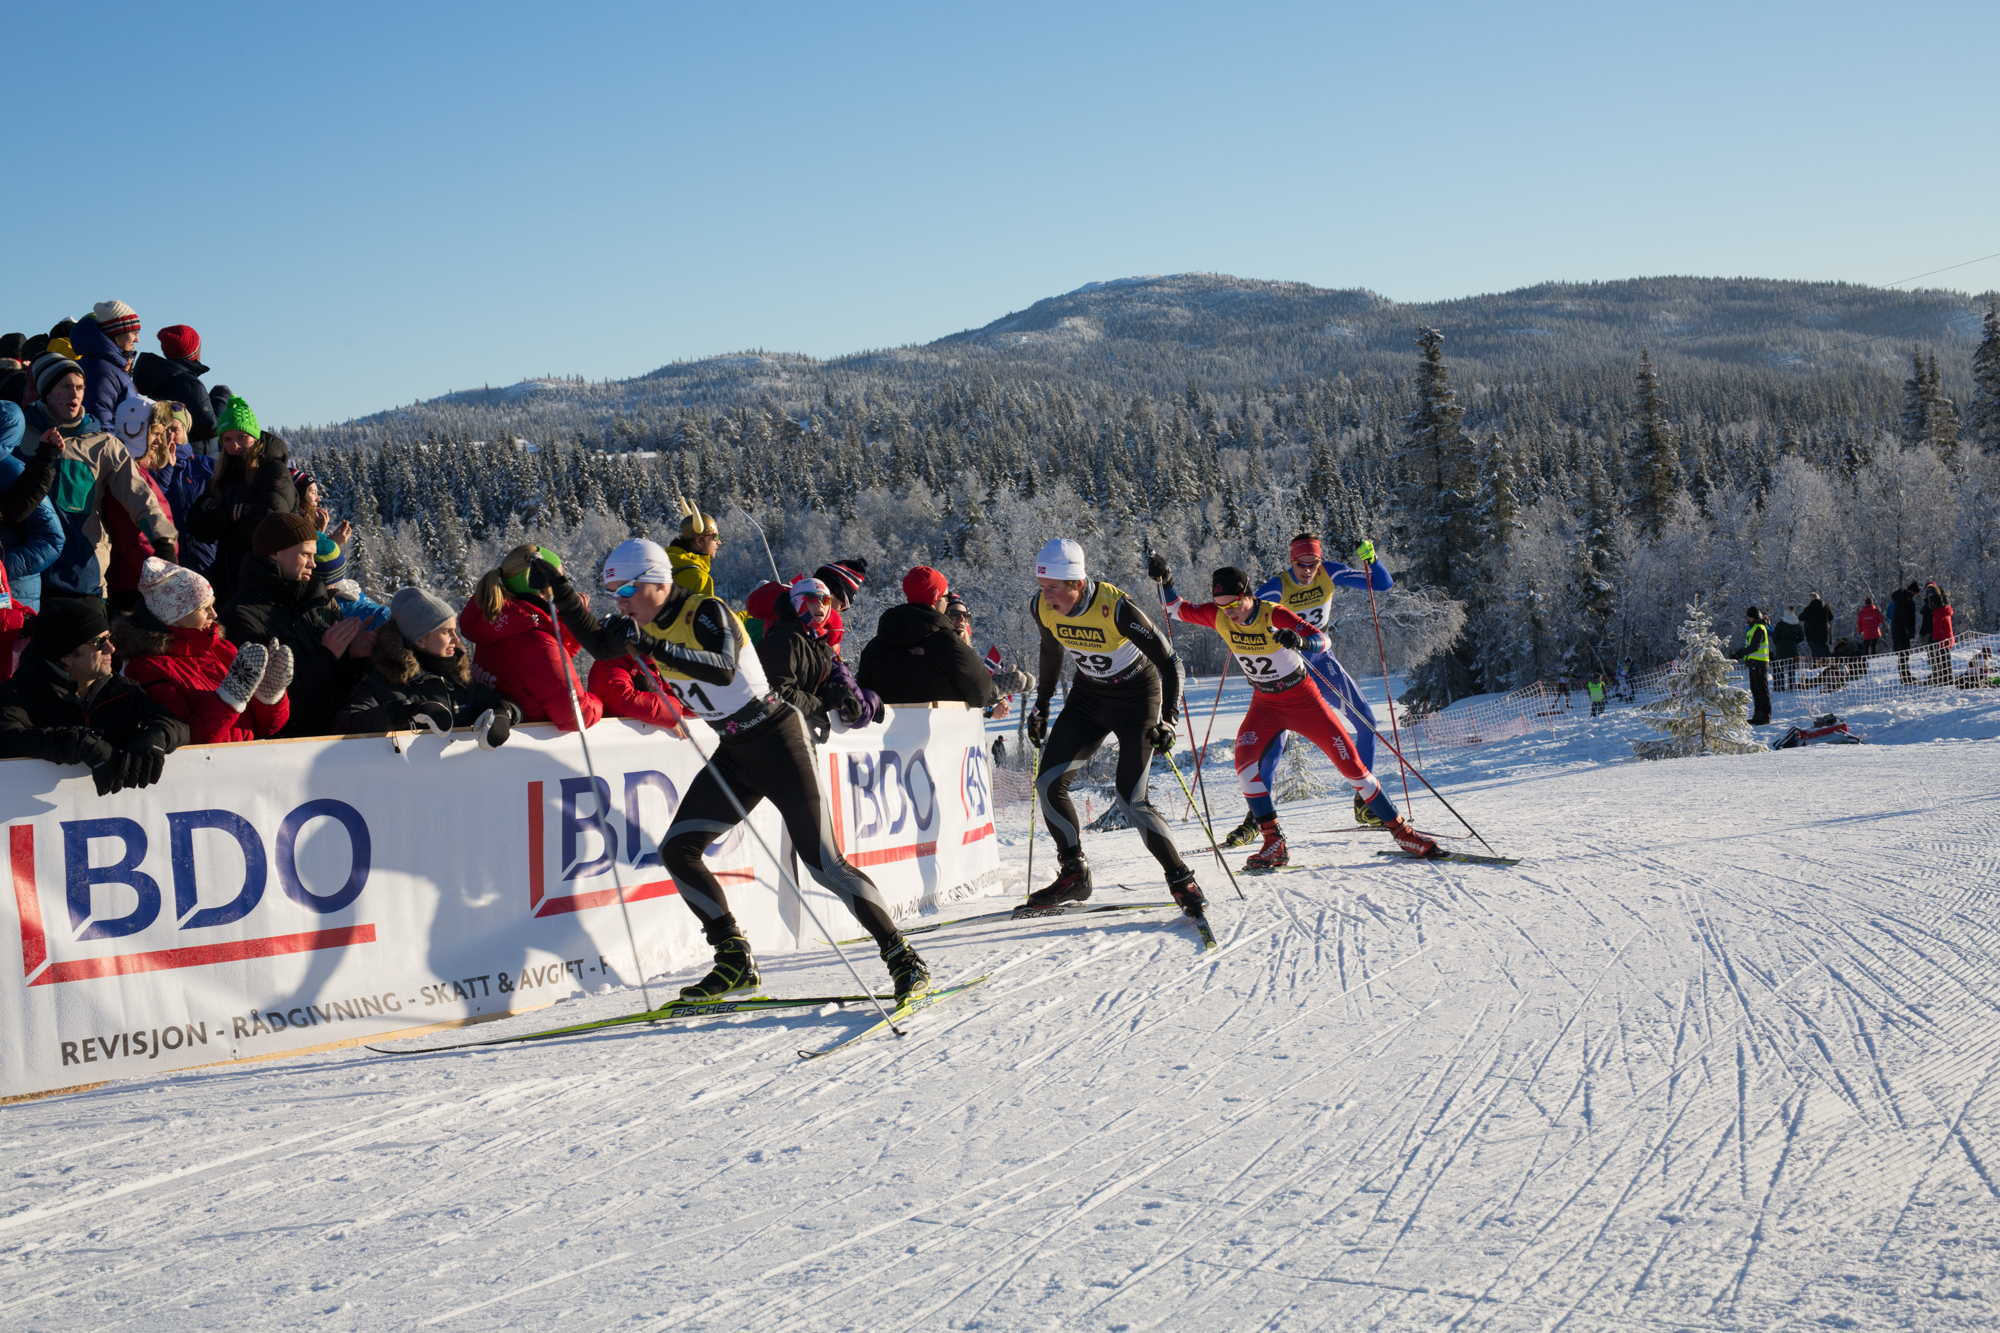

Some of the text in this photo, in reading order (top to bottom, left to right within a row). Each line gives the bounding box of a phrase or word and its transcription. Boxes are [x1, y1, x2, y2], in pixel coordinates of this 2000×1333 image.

[1290, 589, 1323, 603] GLAVA
[1058, 627, 1103, 641] GLAVA
[1232, 634, 1265, 645] GLAVA
[1064, 640, 1102, 648] ISOLASJON
[1239, 656, 1277, 675] 32
[739, 712, 767, 731] Statoil
[846, 749, 936, 840] BDO
[59, 798, 371, 942] BDO
[1010, 908, 1065, 921] FISCHER
[61, 1021, 208, 1066] REVISJON
[232, 992, 403, 1040] RÅDGIVNING
[419, 975, 490, 1007] SKATT
[498, 972, 515, 994] &
[519, 958, 585, 991] AVGIFT
[670, 1003, 738, 1018] FISCHER
